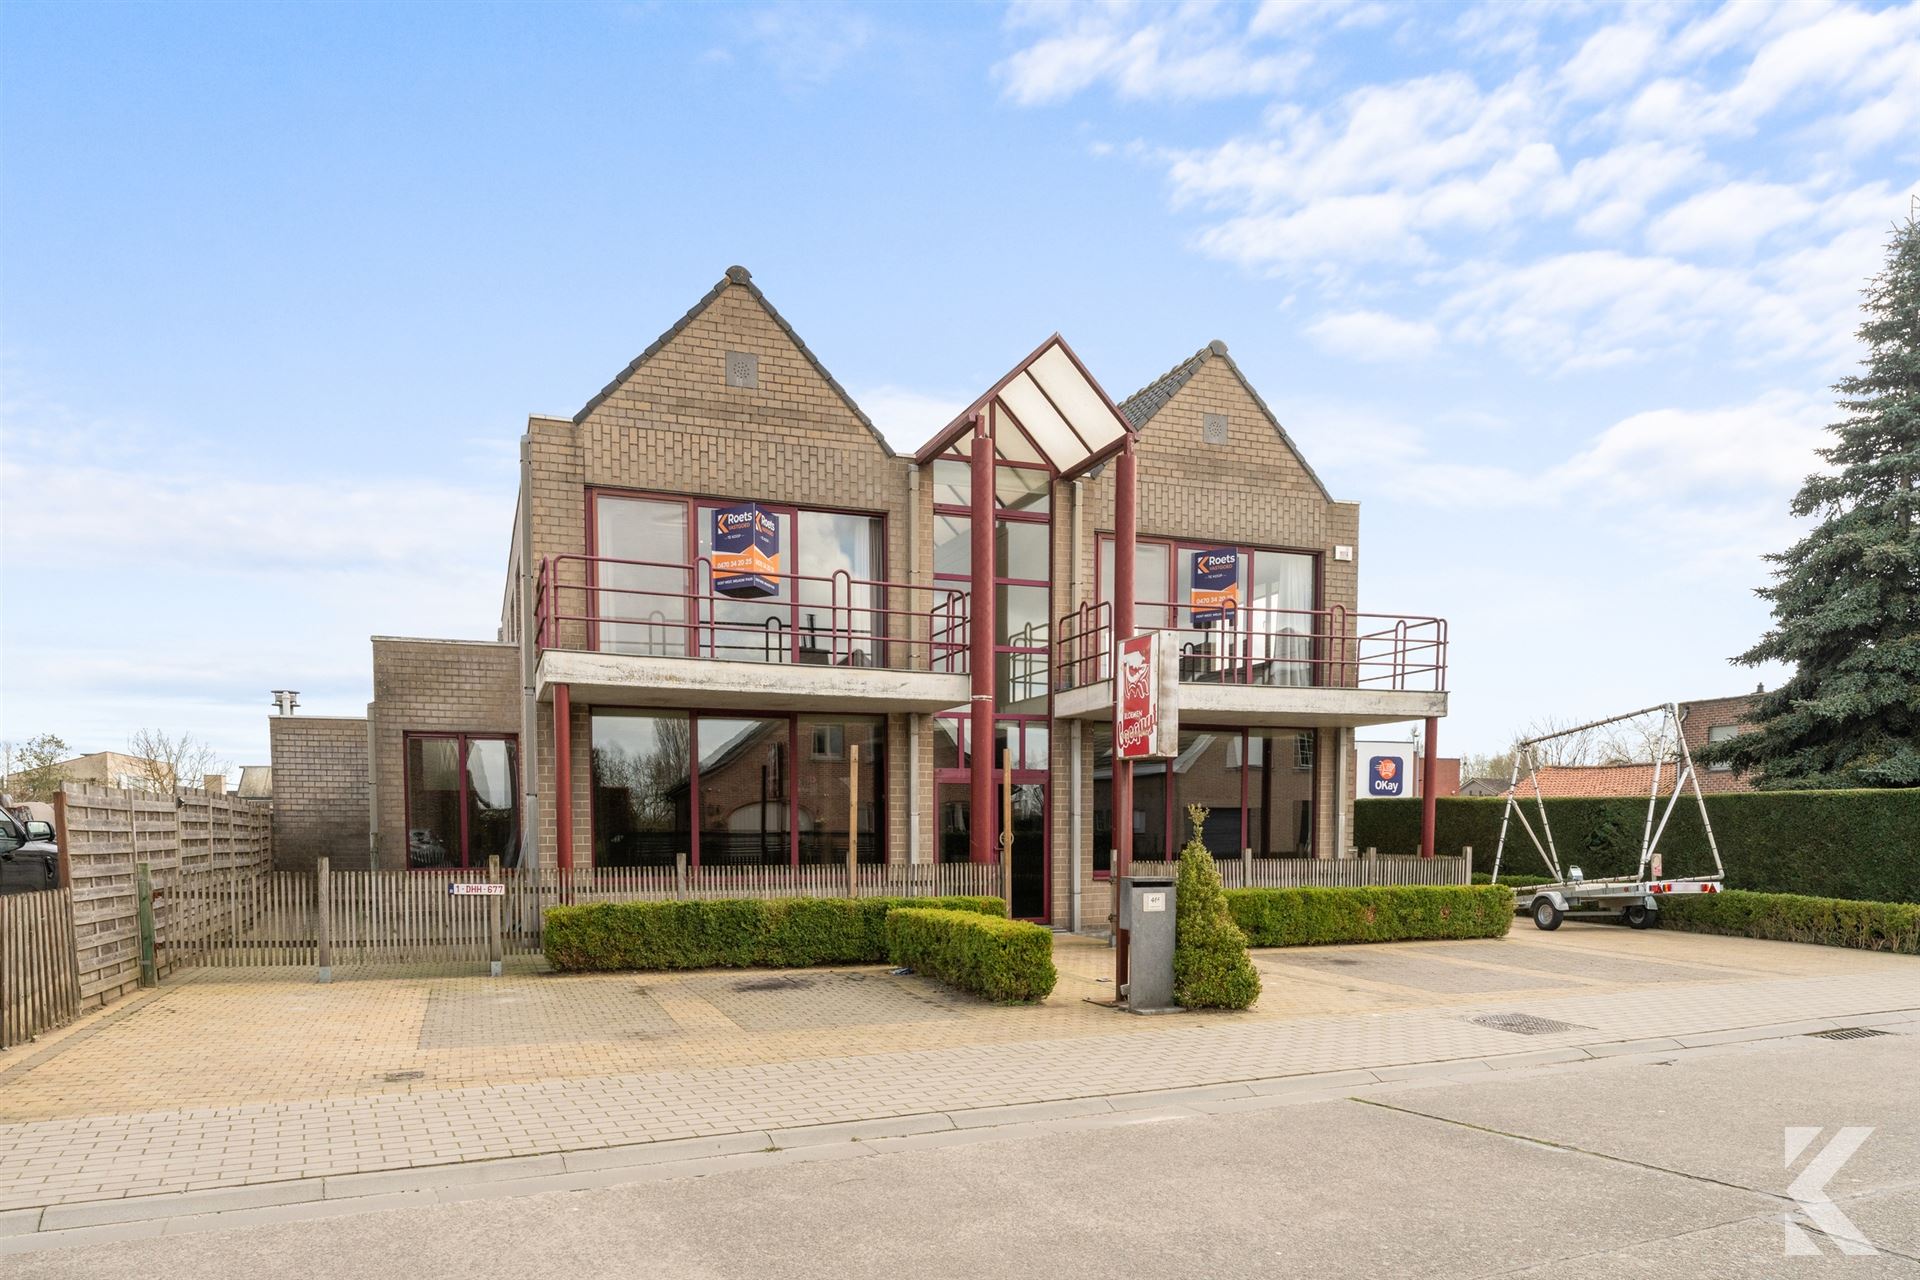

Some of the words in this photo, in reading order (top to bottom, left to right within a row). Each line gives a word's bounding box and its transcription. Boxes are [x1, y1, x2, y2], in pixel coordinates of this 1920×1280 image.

[728, 512, 753, 525] Roets
[1209, 555, 1236, 565] Roets
[1375, 780, 1399, 793] OKay
